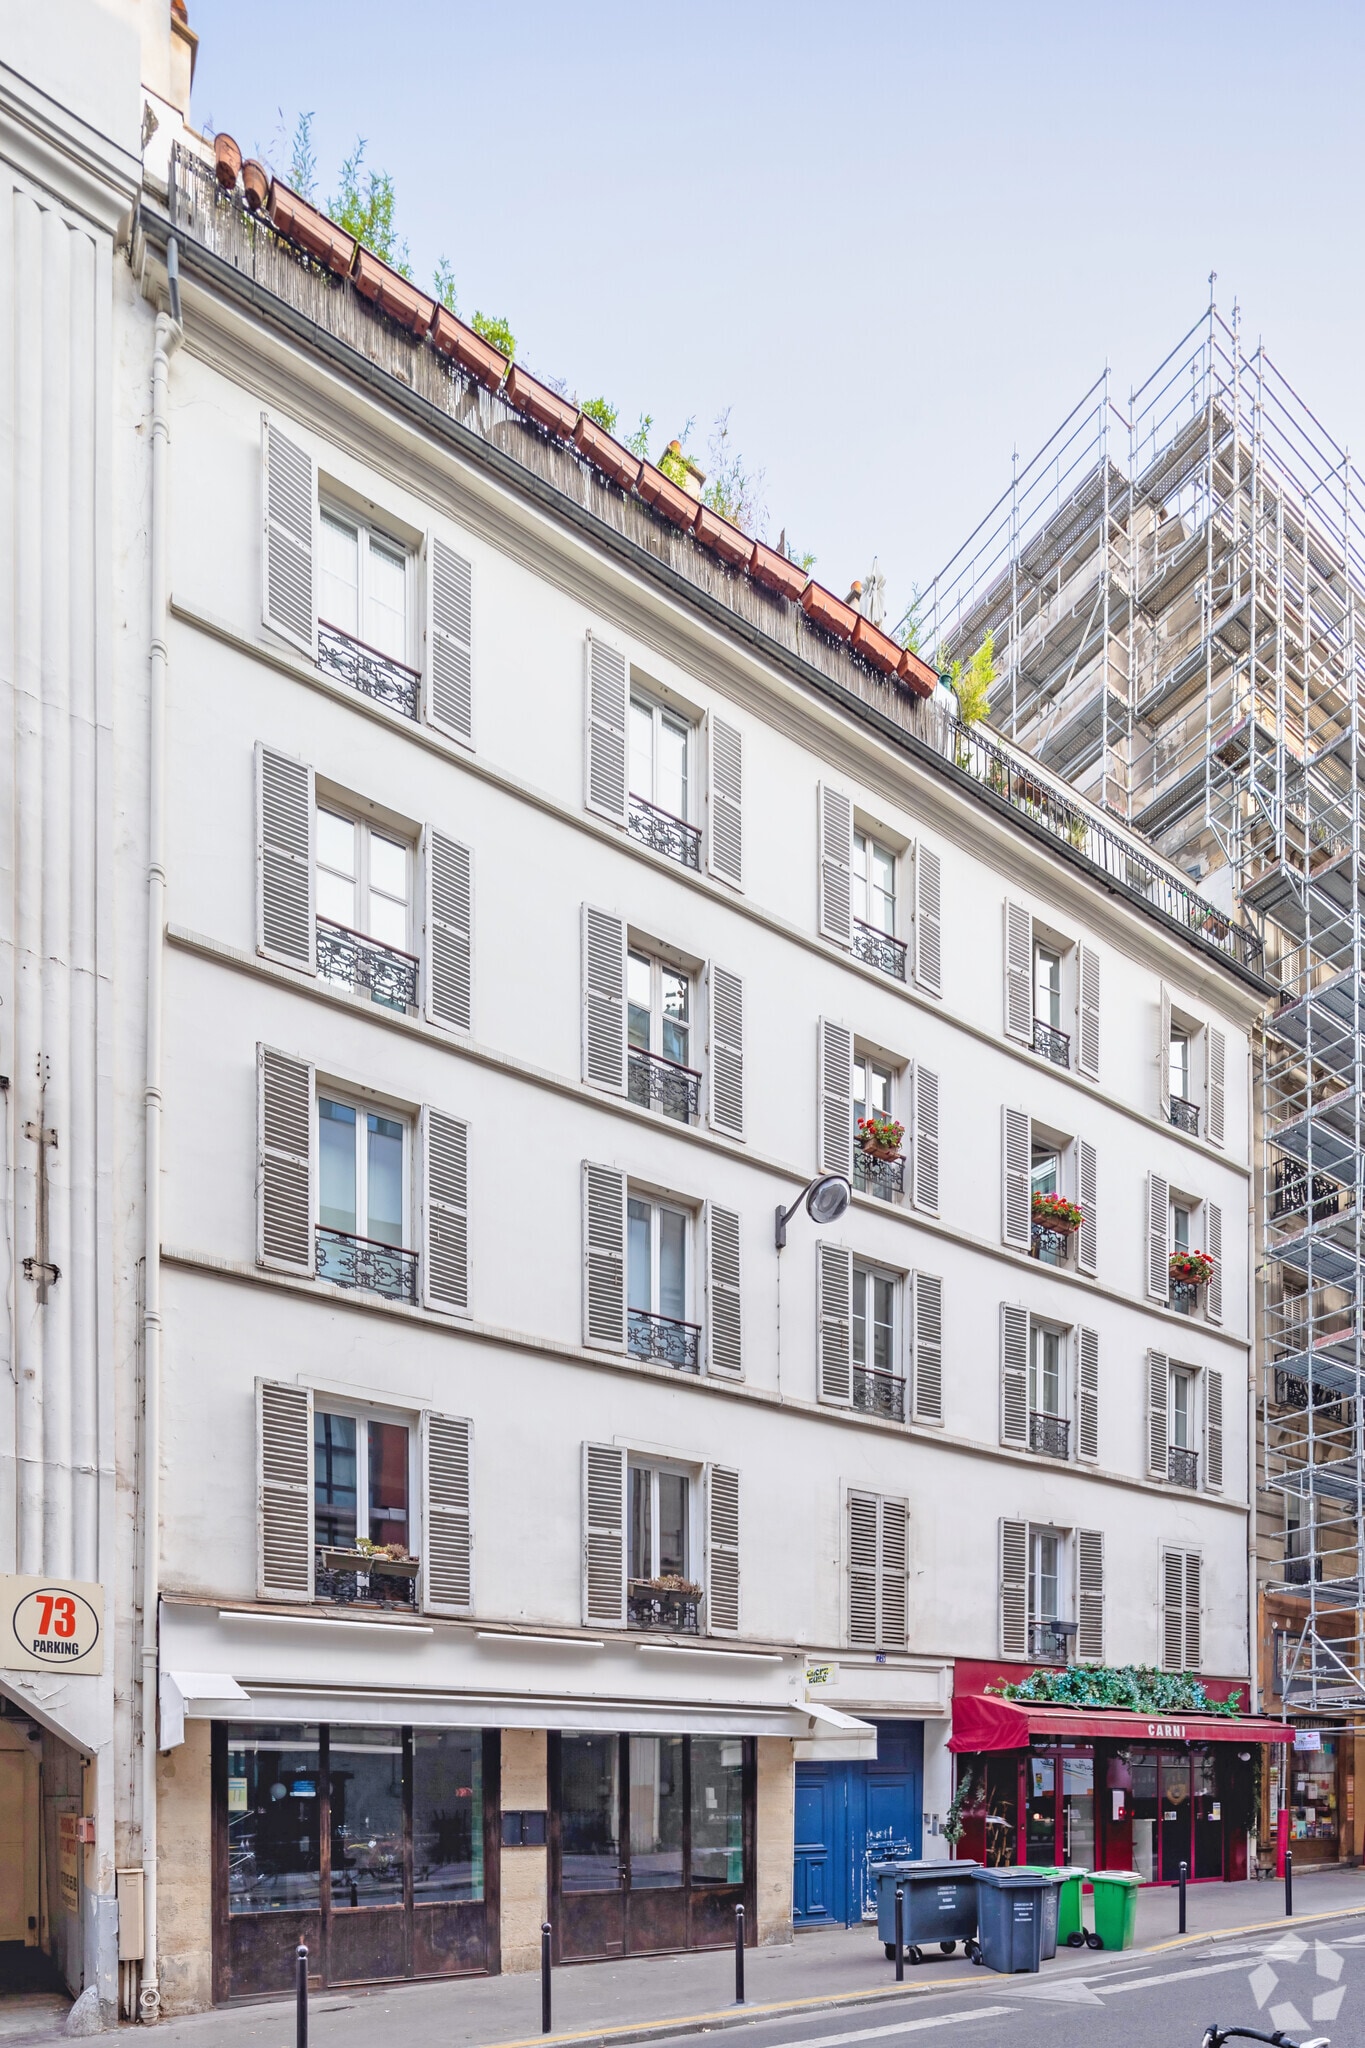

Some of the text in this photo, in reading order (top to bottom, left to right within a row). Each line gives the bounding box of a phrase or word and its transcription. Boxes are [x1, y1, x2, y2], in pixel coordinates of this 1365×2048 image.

[36, 1595, 76, 1638] 73
[33, 1639, 79, 1656] PARKING
[1148, 1723, 1186, 1738] CARNI
